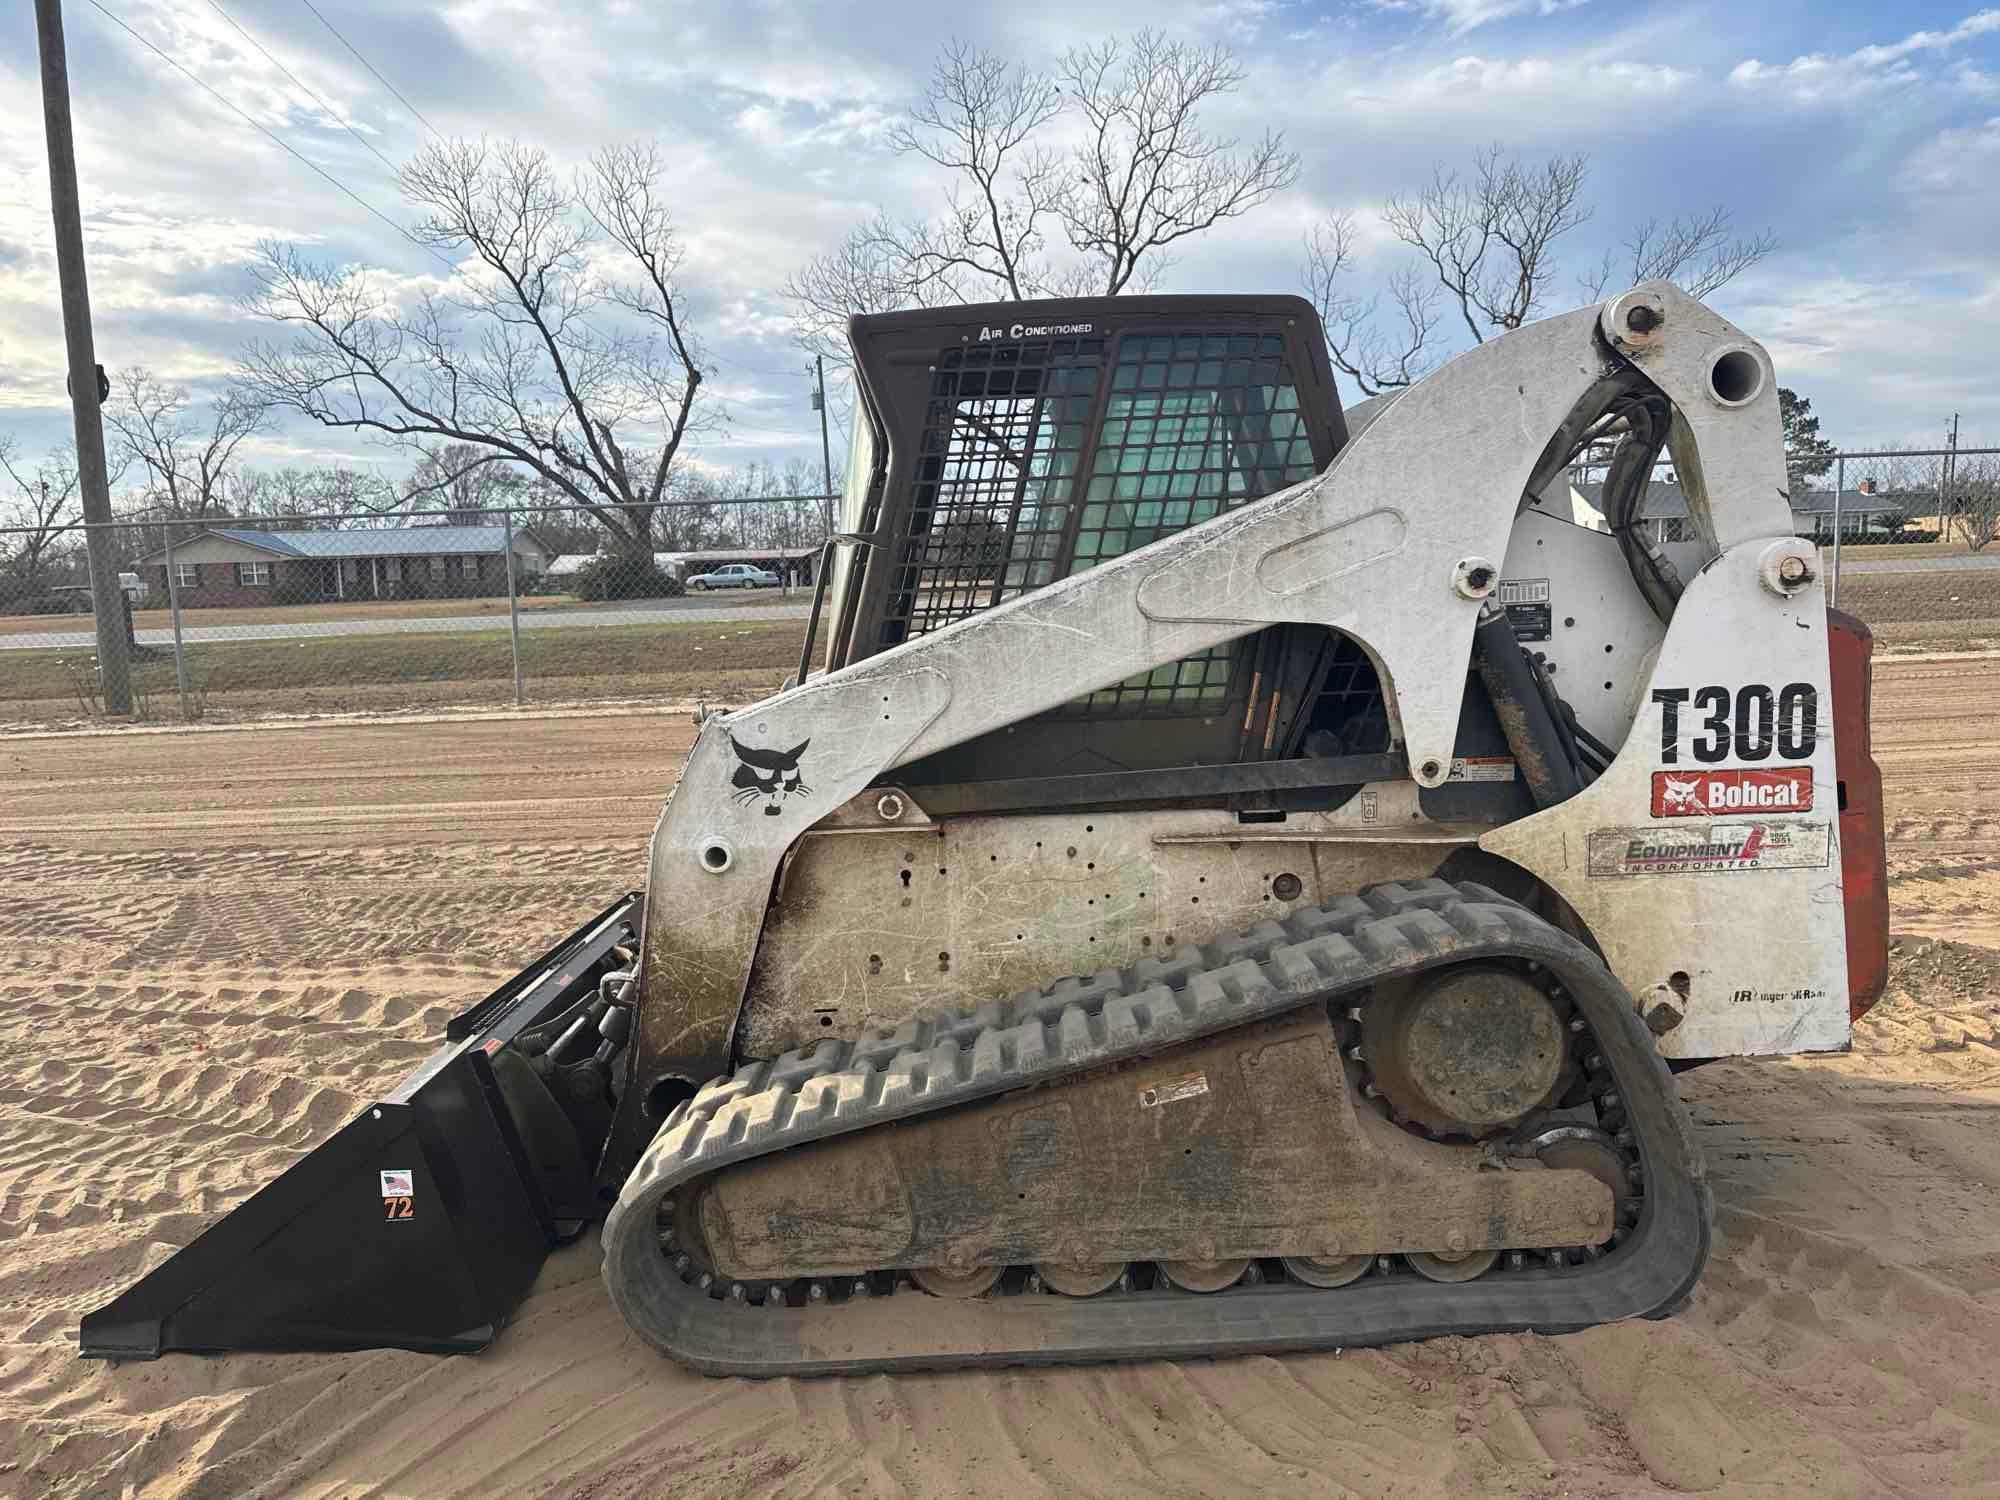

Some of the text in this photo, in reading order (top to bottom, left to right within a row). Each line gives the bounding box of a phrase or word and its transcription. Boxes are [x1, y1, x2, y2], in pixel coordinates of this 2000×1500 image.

[979, 324, 1092, 341] AIR CONDITIONED
[1651, 683, 1817, 763] T300
[1708, 780, 1799, 808] Bobcat
[1626, 840, 1743, 858] EQUIPMENT
[1624, 860, 1758, 873] INCORPORATED
[385, 1197, 413, 1218] 72
